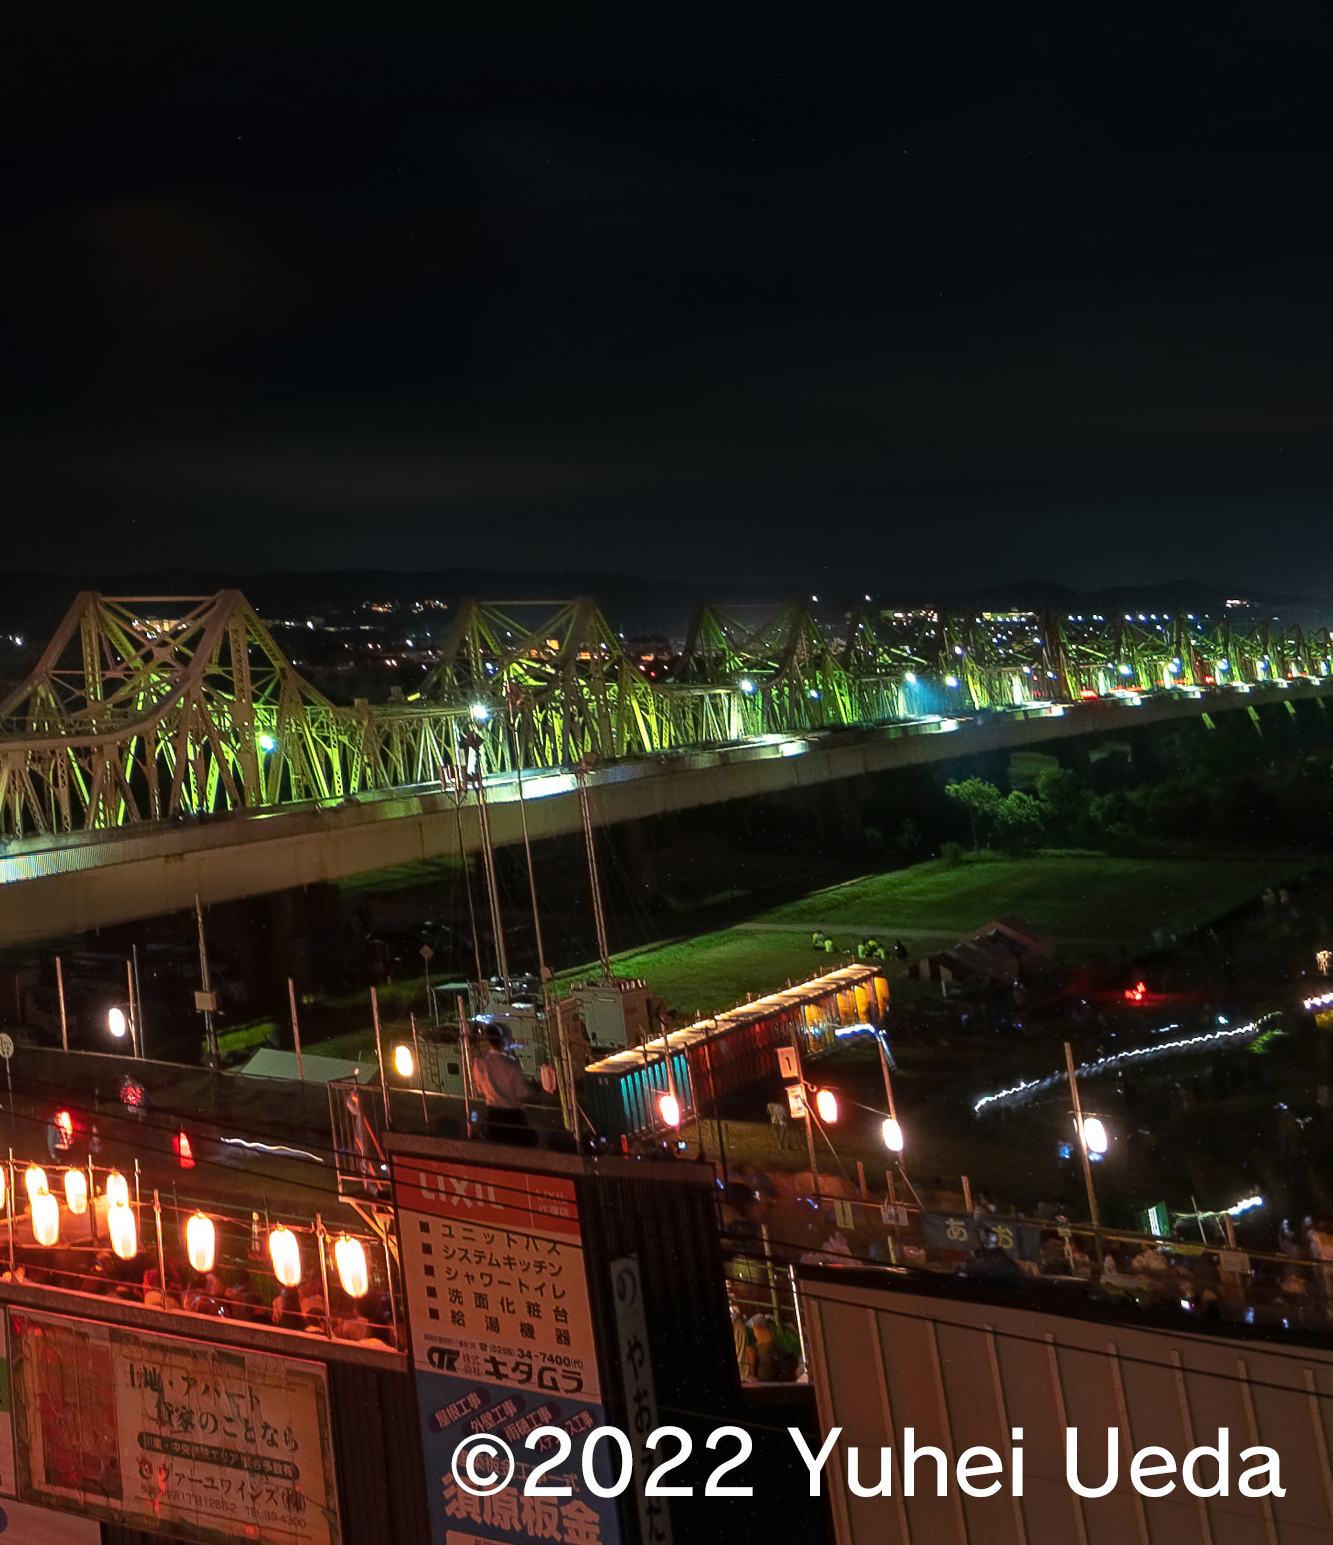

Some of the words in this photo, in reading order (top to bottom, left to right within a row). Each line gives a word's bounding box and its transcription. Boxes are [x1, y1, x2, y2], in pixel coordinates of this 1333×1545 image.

[419, 1172, 504, 1210] LIXIL
[442, 1245, 563, 1278] システムキッチン
[445, 1266, 566, 1301] シャワートイレ
[447, 1286, 569, 1325] 洗面化粧台
[483, 1356, 584, 1394] キタムラ
[435, 1391, 482, 1429] 屋根工事
[470, 1398, 518, 1434] 外壁工事
